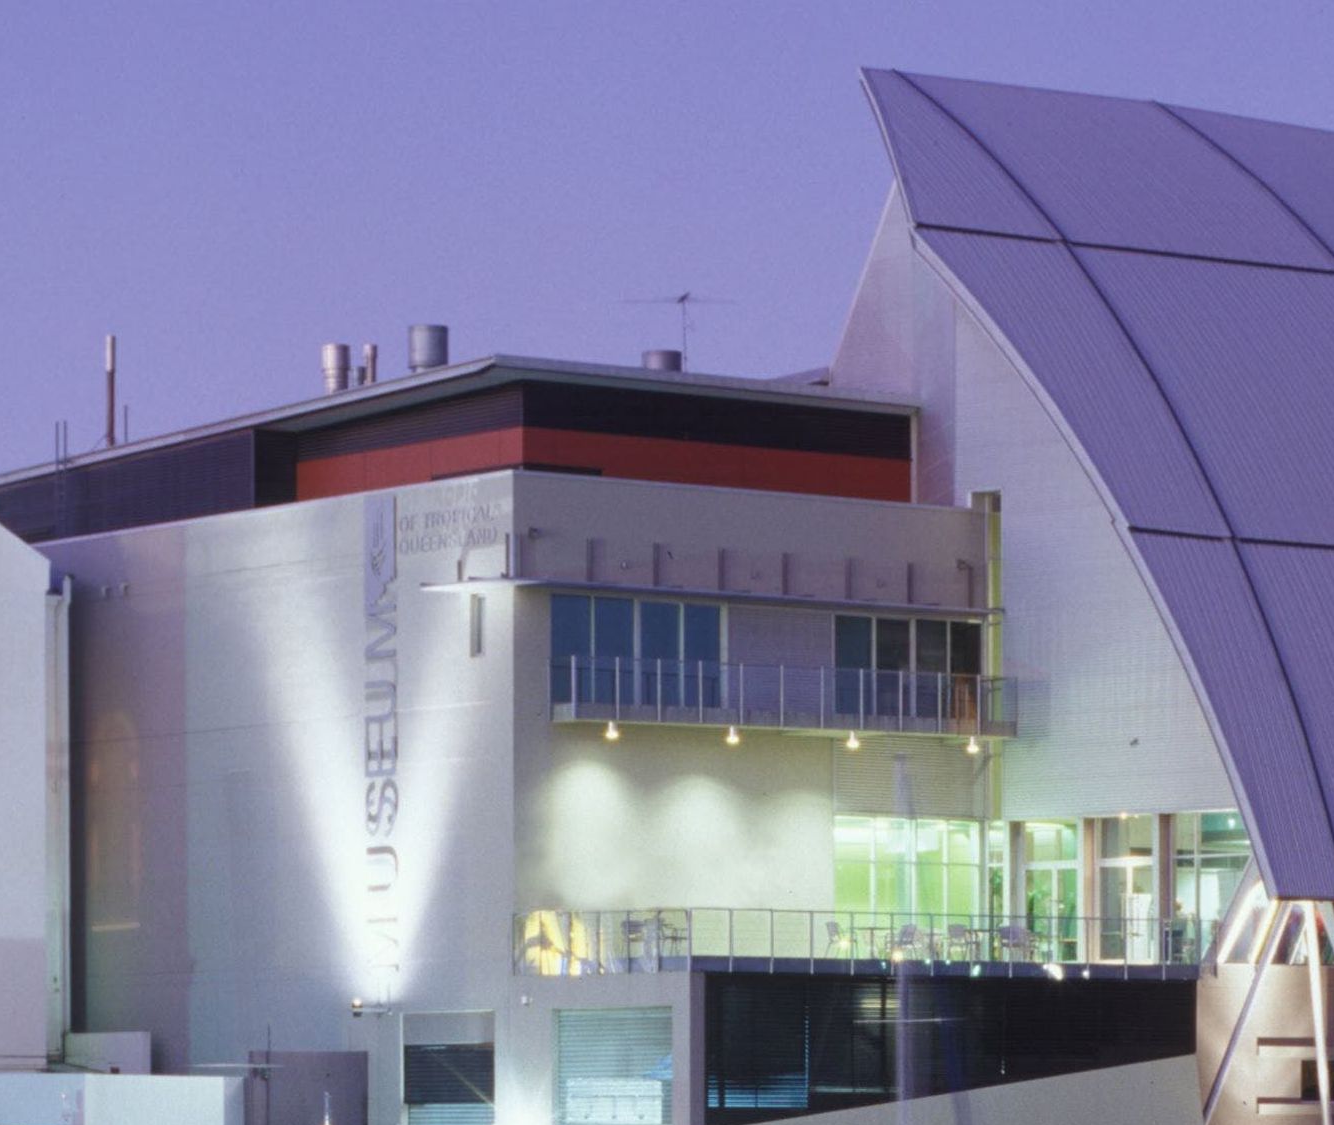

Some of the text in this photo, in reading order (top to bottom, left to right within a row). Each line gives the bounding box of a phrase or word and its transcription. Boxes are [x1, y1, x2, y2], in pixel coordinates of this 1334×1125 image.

[399, 514, 417, 532] OF
[424, 503, 494, 530] TROPICAL
[399, 526, 498, 555] QUEENSLAND
[363, 600, 399, 974] MUSEUM
